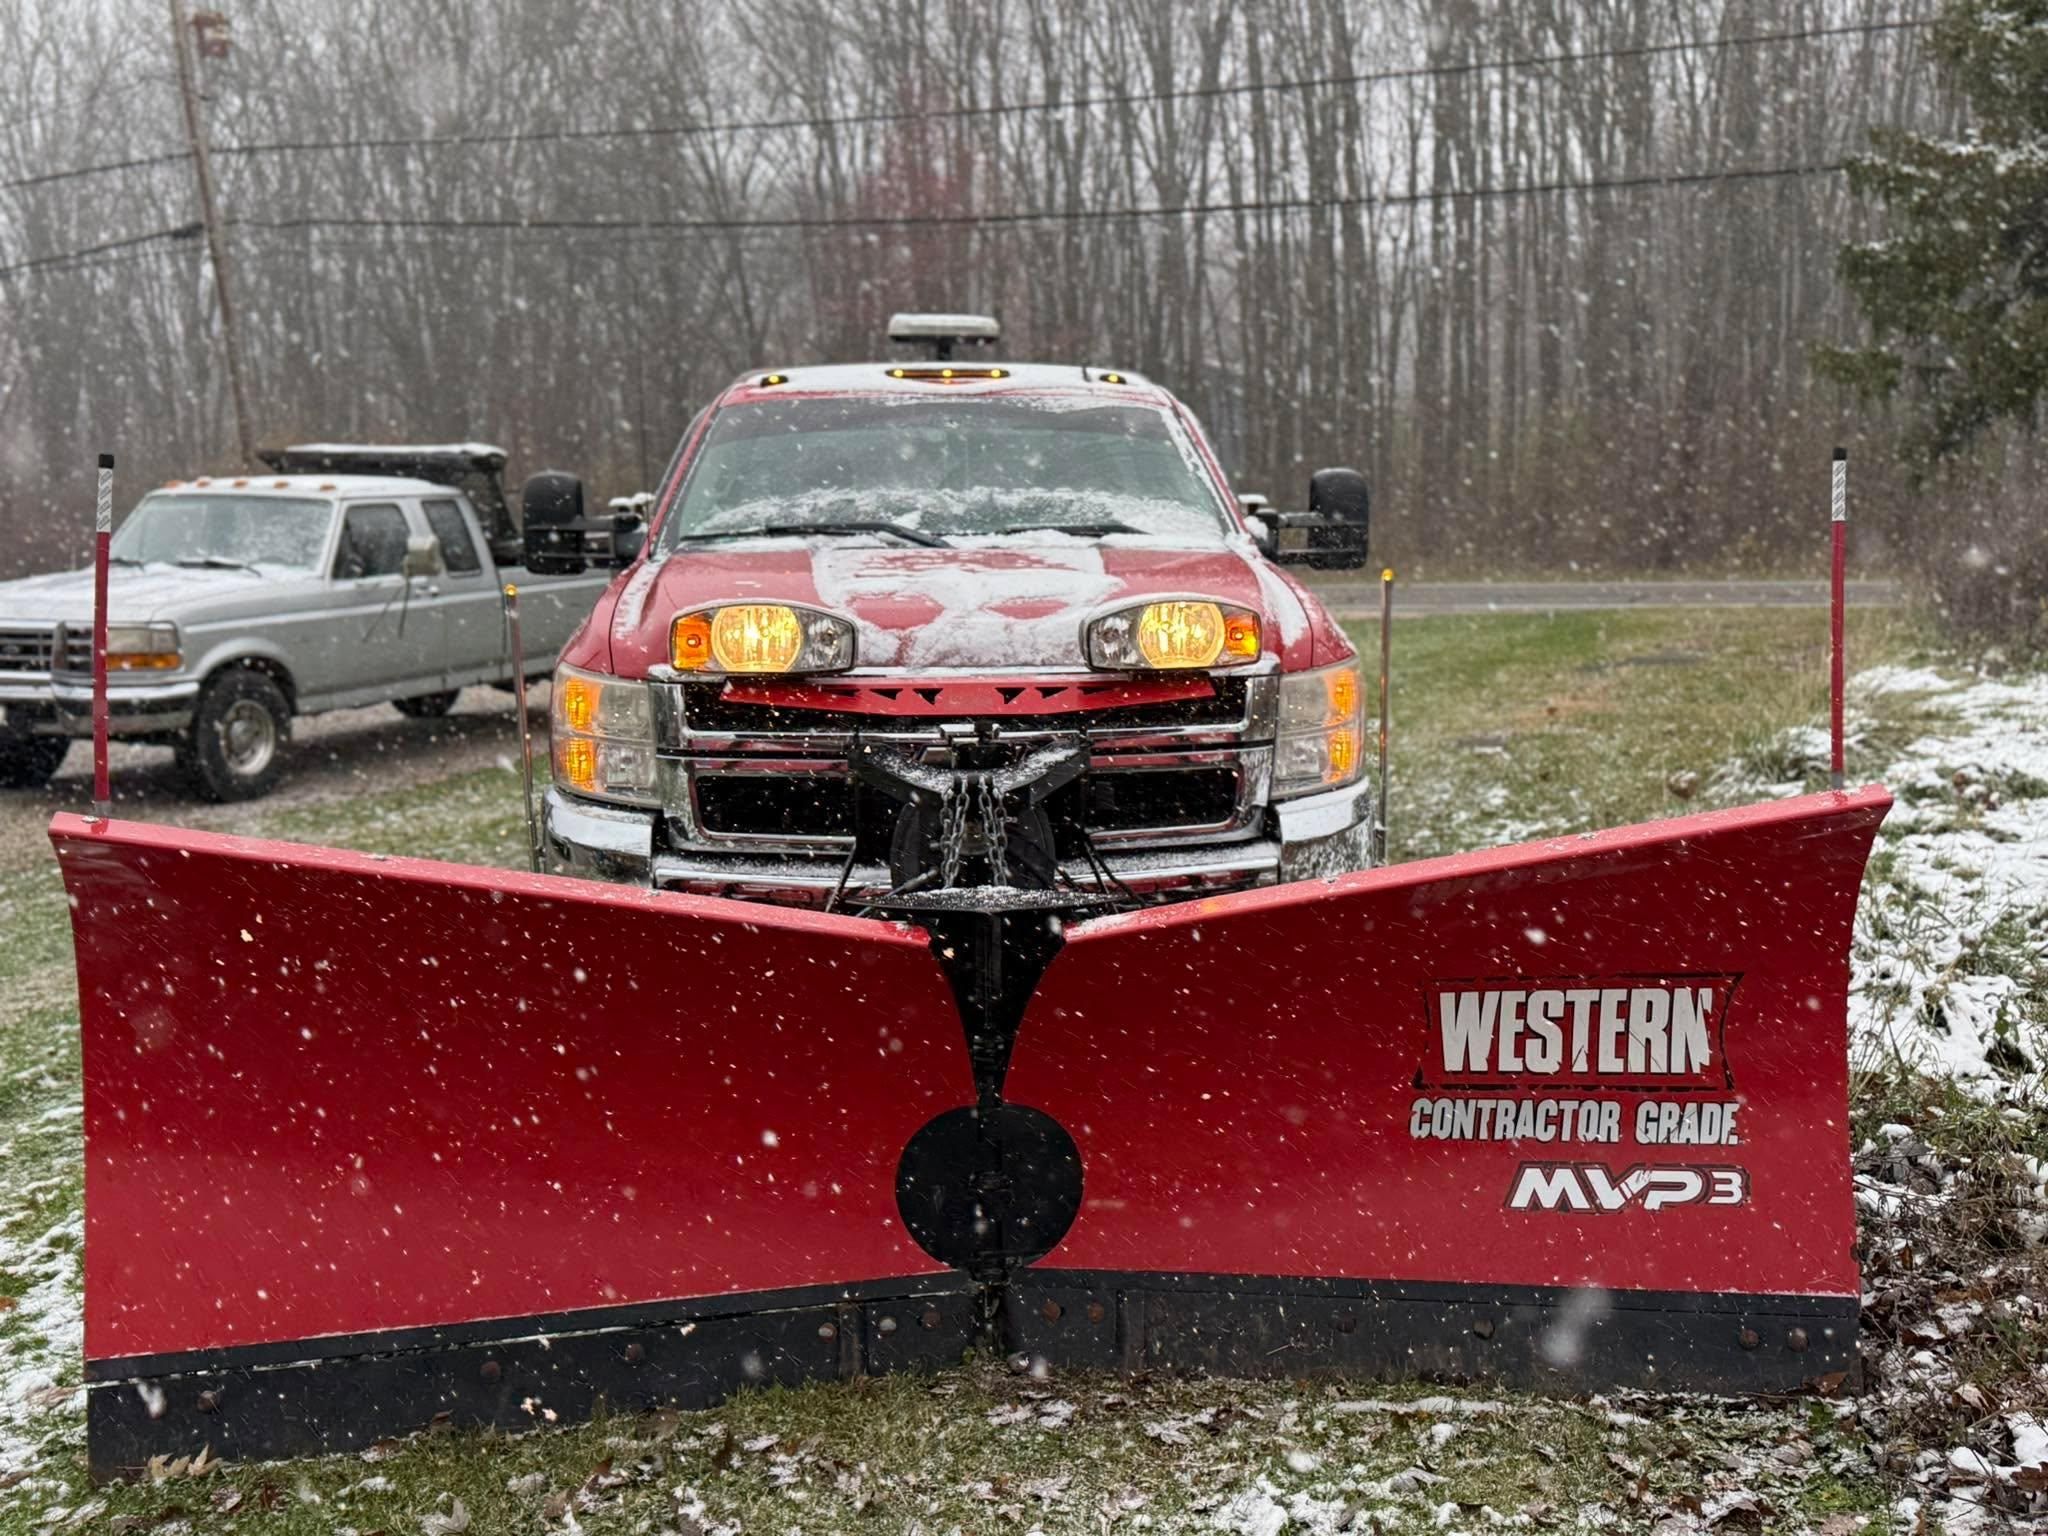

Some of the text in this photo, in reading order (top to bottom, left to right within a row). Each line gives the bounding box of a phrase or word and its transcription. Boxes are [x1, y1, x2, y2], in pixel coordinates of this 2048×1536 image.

[1439, 988, 1712, 1074] WESTERN
[1410, 1098, 1740, 1145] CONTRACTOR GRADE
